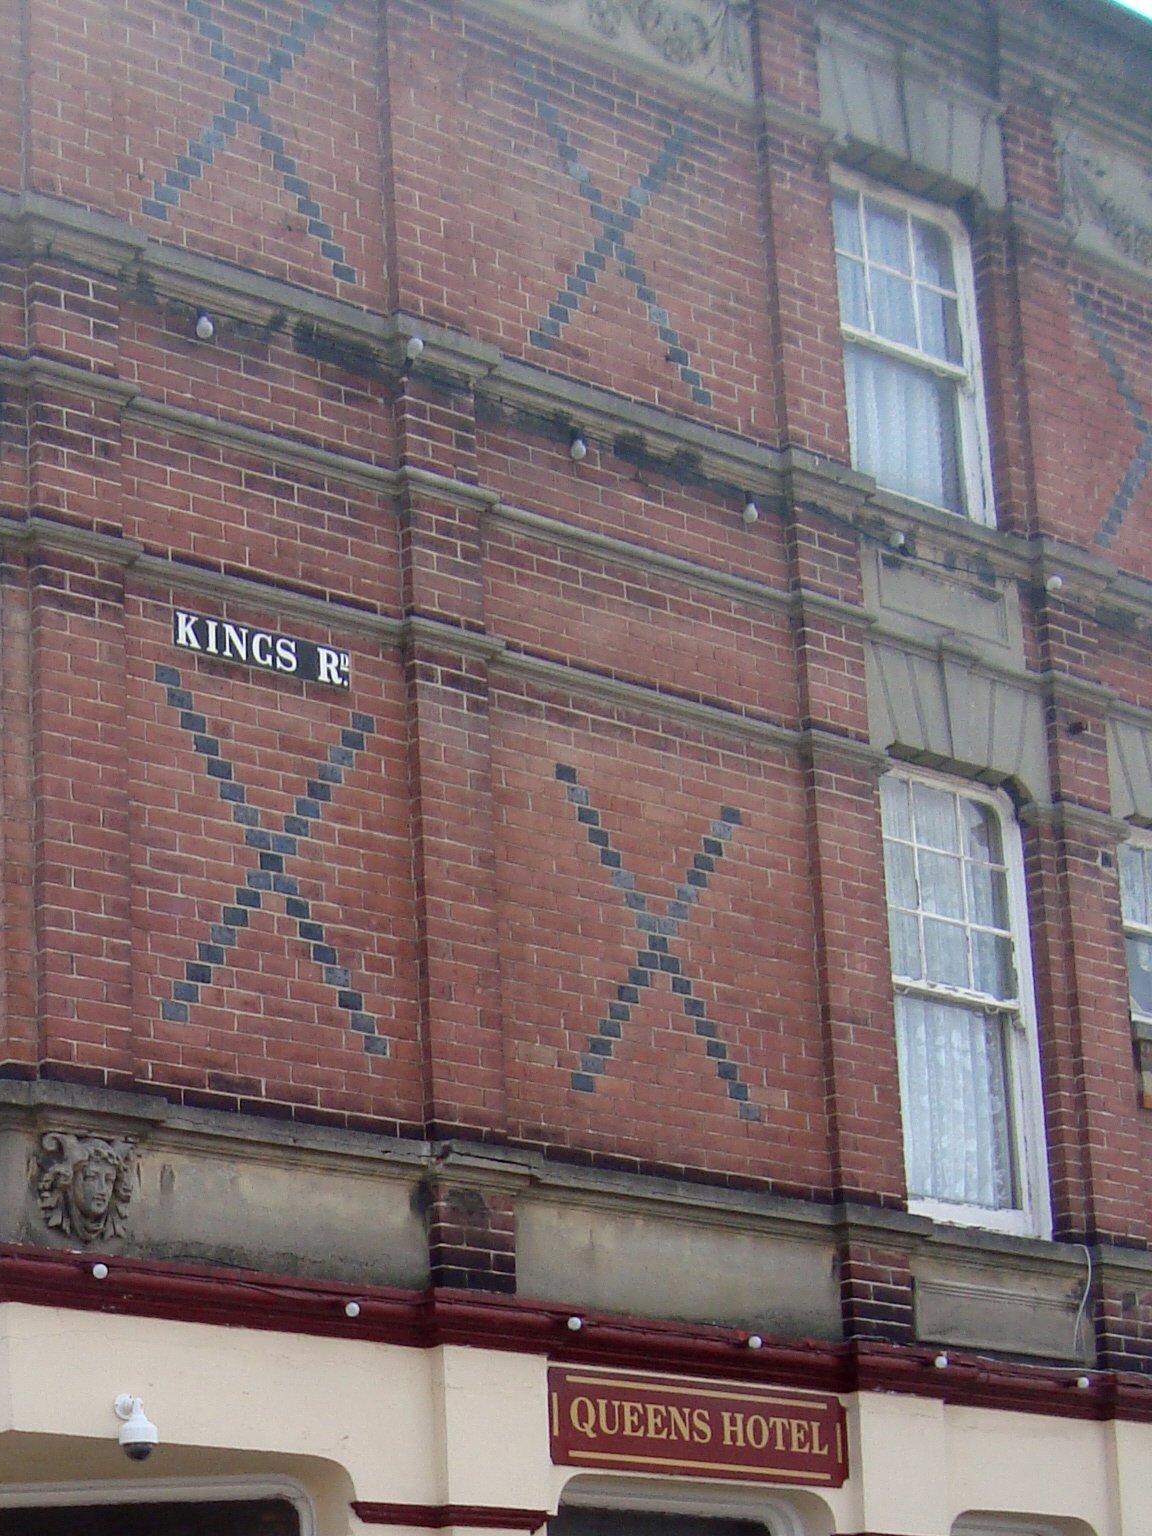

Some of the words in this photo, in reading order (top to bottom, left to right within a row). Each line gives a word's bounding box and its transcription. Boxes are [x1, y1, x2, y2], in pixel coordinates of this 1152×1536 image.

[175, 611, 298, 673] KINGS
[569, 1396, 713, 1444] QUEENS
[720, 1410, 829, 1456] HOTEL
